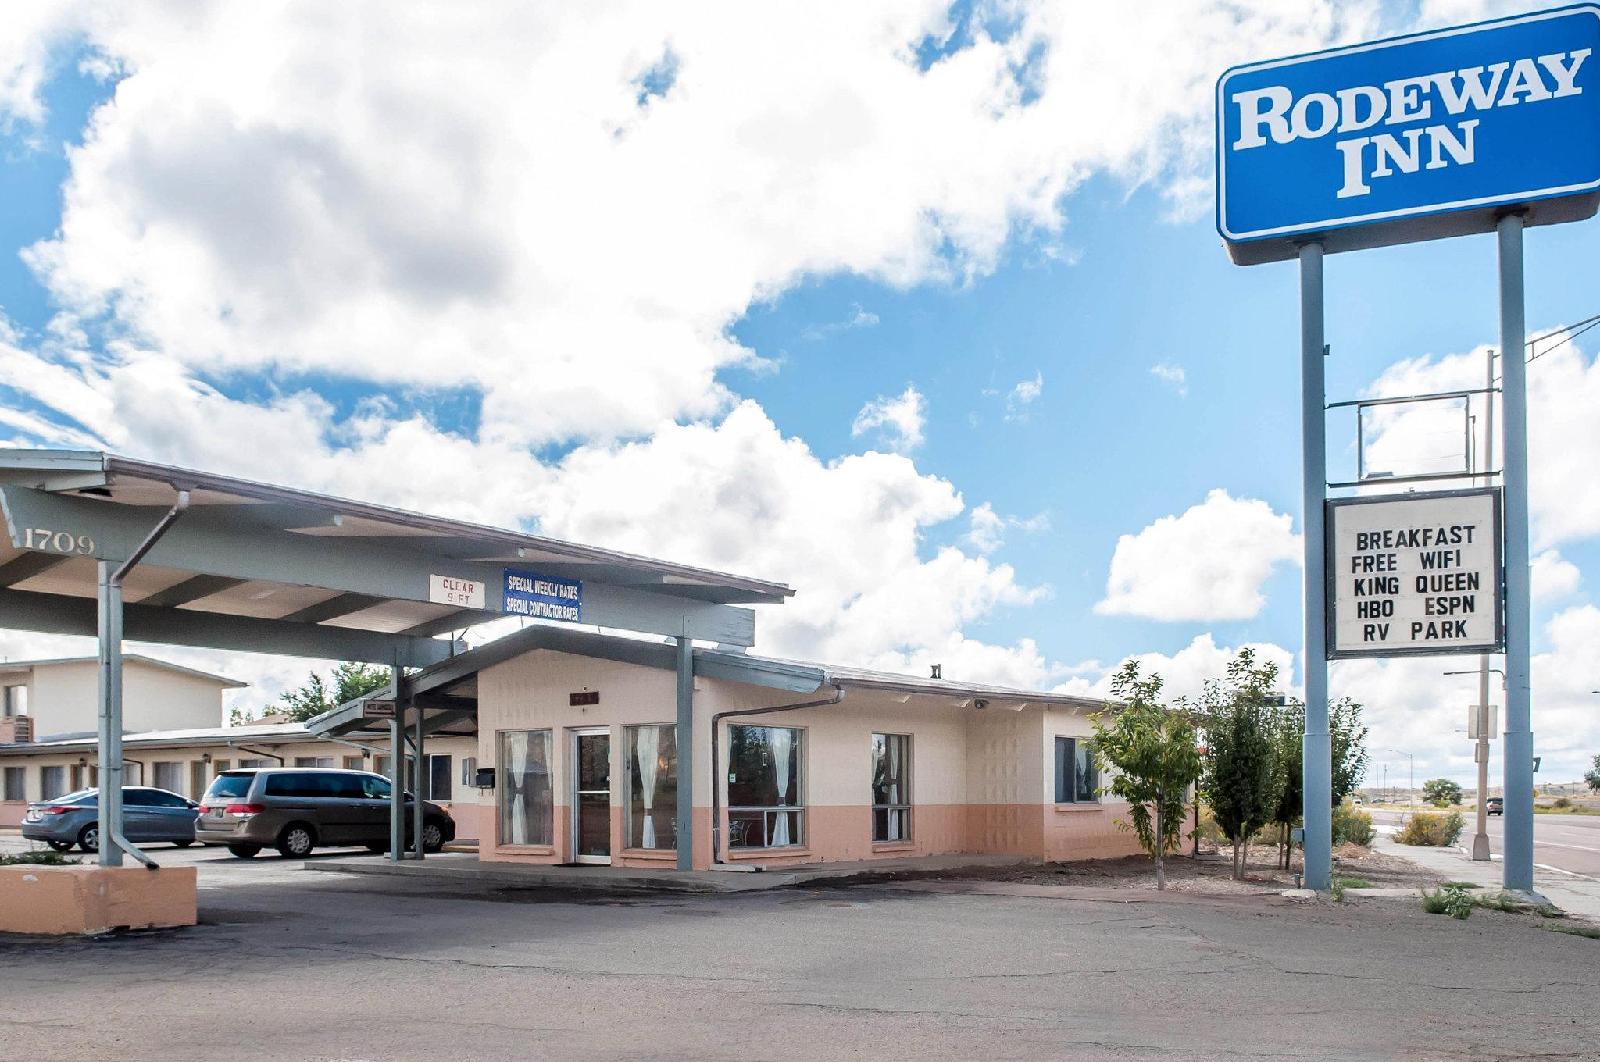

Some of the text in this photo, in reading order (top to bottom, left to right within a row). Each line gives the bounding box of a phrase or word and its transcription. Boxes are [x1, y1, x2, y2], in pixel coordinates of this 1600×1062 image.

[1232, 48, 1592, 150] RODEWAY
[1336, 119, 1480, 199] INN
[25, 528, 95, 555] 1709
[1357, 525, 1475, 551] BREAKFAST
[1352, 550, 1461, 574] FREE WIFI
[443, 579, 474, 593] CLEAR
[508, 576, 578, 600] SPECIAL WEEKLY RATES
[1354, 572, 1479, 596] KING QUEEN
[459, 594, 470, 604] FT
[507, 597, 579, 621] SPECIAL CONTRACTOR RATES
[1357, 595, 1475, 619] HBO ESPN
[1364, 620, 1467, 642] RV PARK
